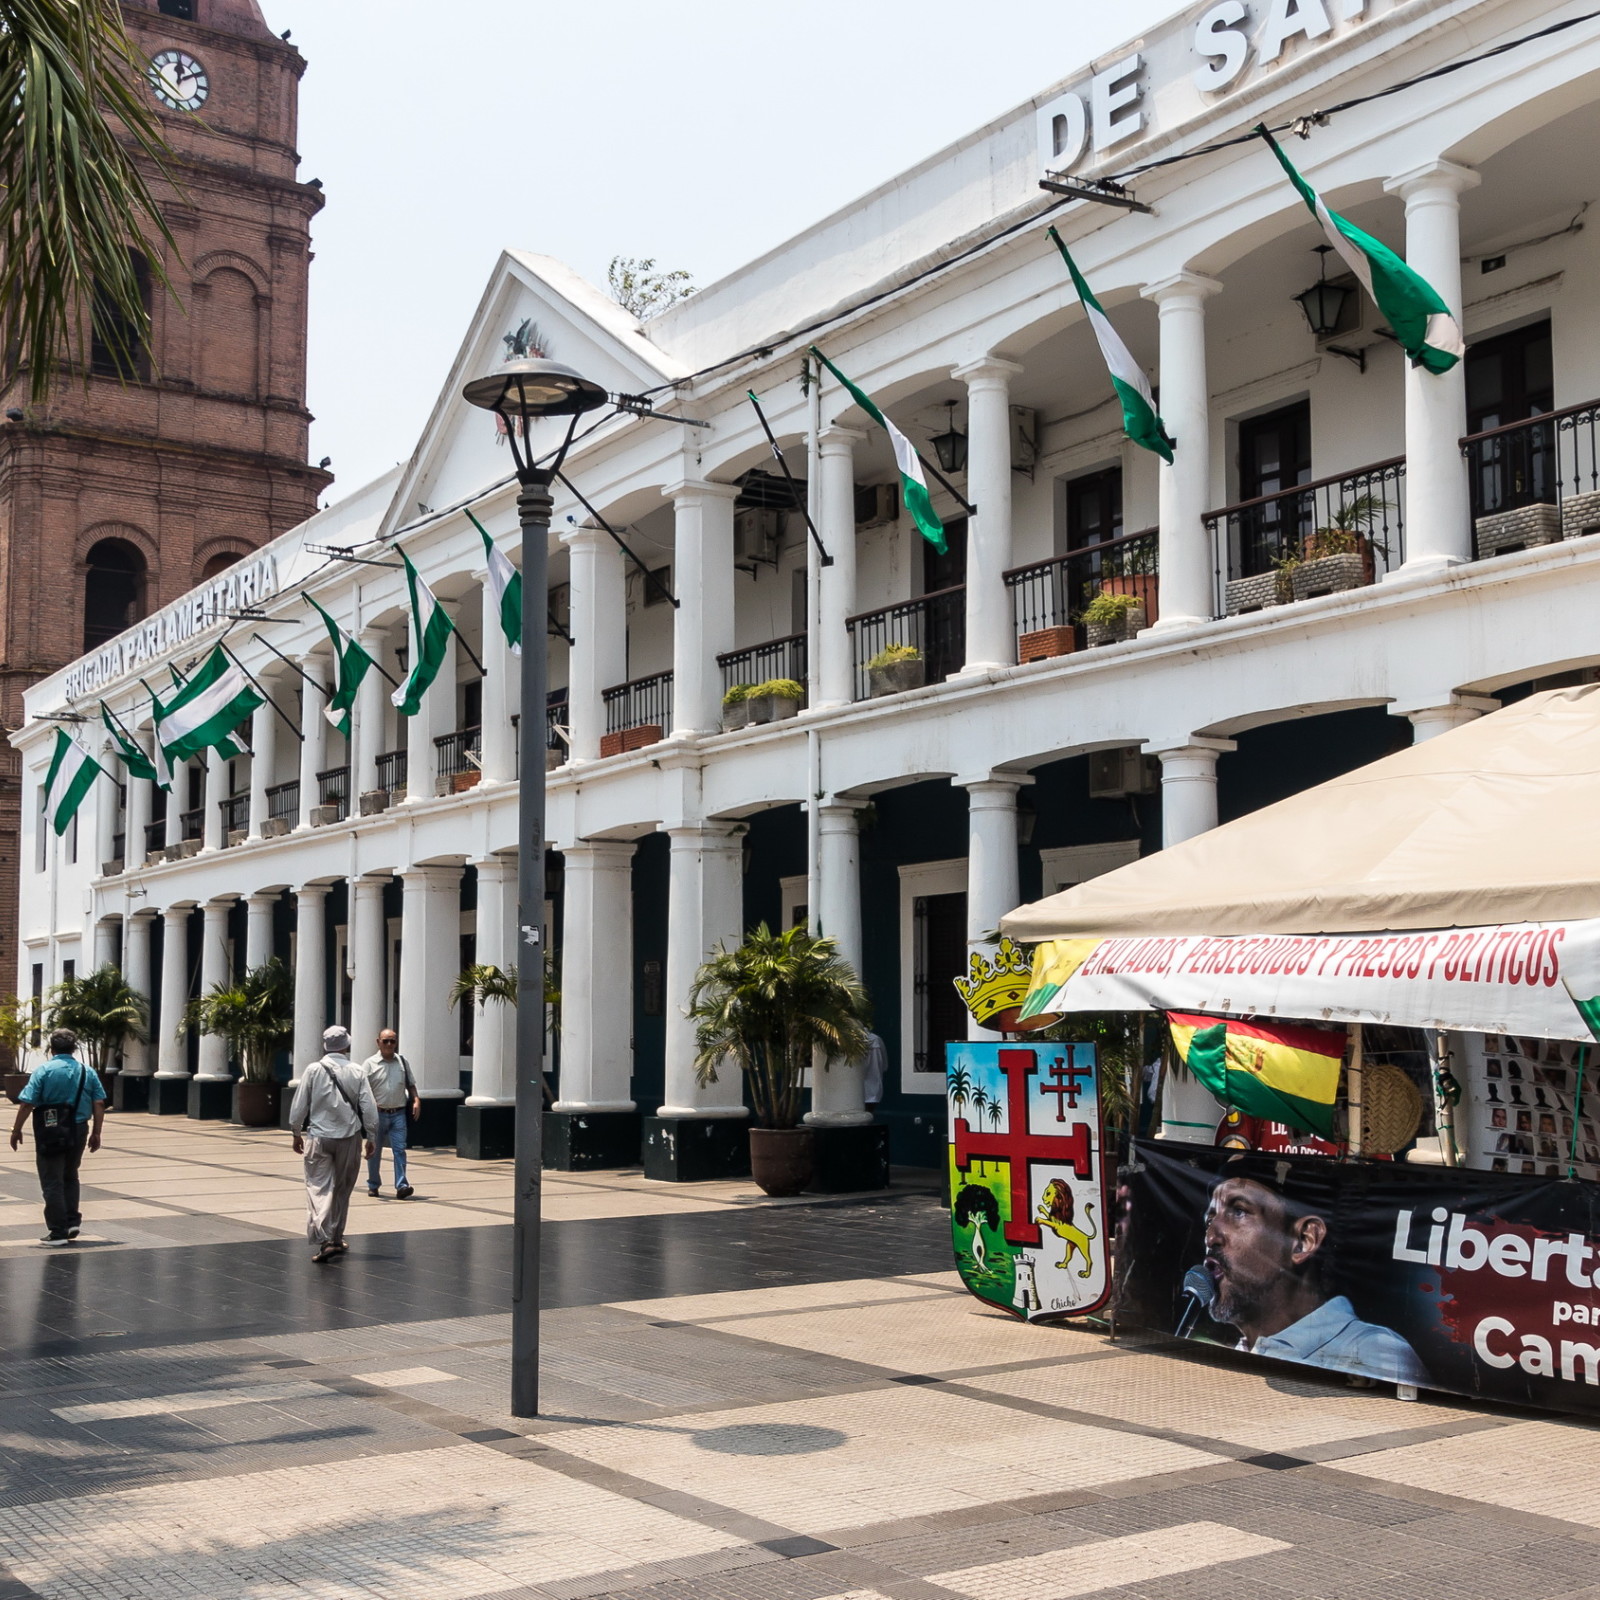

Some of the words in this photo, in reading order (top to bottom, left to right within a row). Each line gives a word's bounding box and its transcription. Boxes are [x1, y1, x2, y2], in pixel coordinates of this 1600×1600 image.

[1037, 53, 1147, 173] DE
[1195, 0, 1366, 93] SA
[65, 643, 125, 700] BRIGADA
[123, 554, 279, 675] PARLAMENTARIA
[1081, 938, 1188, 979] EXILIADOS,
[1177, 938, 1329, 976] PERSEGUIDOS
[1317, 939, 1352, 976] Y
[1334, 935, 1438, 980] PRESOS
[1428, 924, 1566, 988] POLÍTICOS
[1392, 1206, 1600, 1290] Libert
